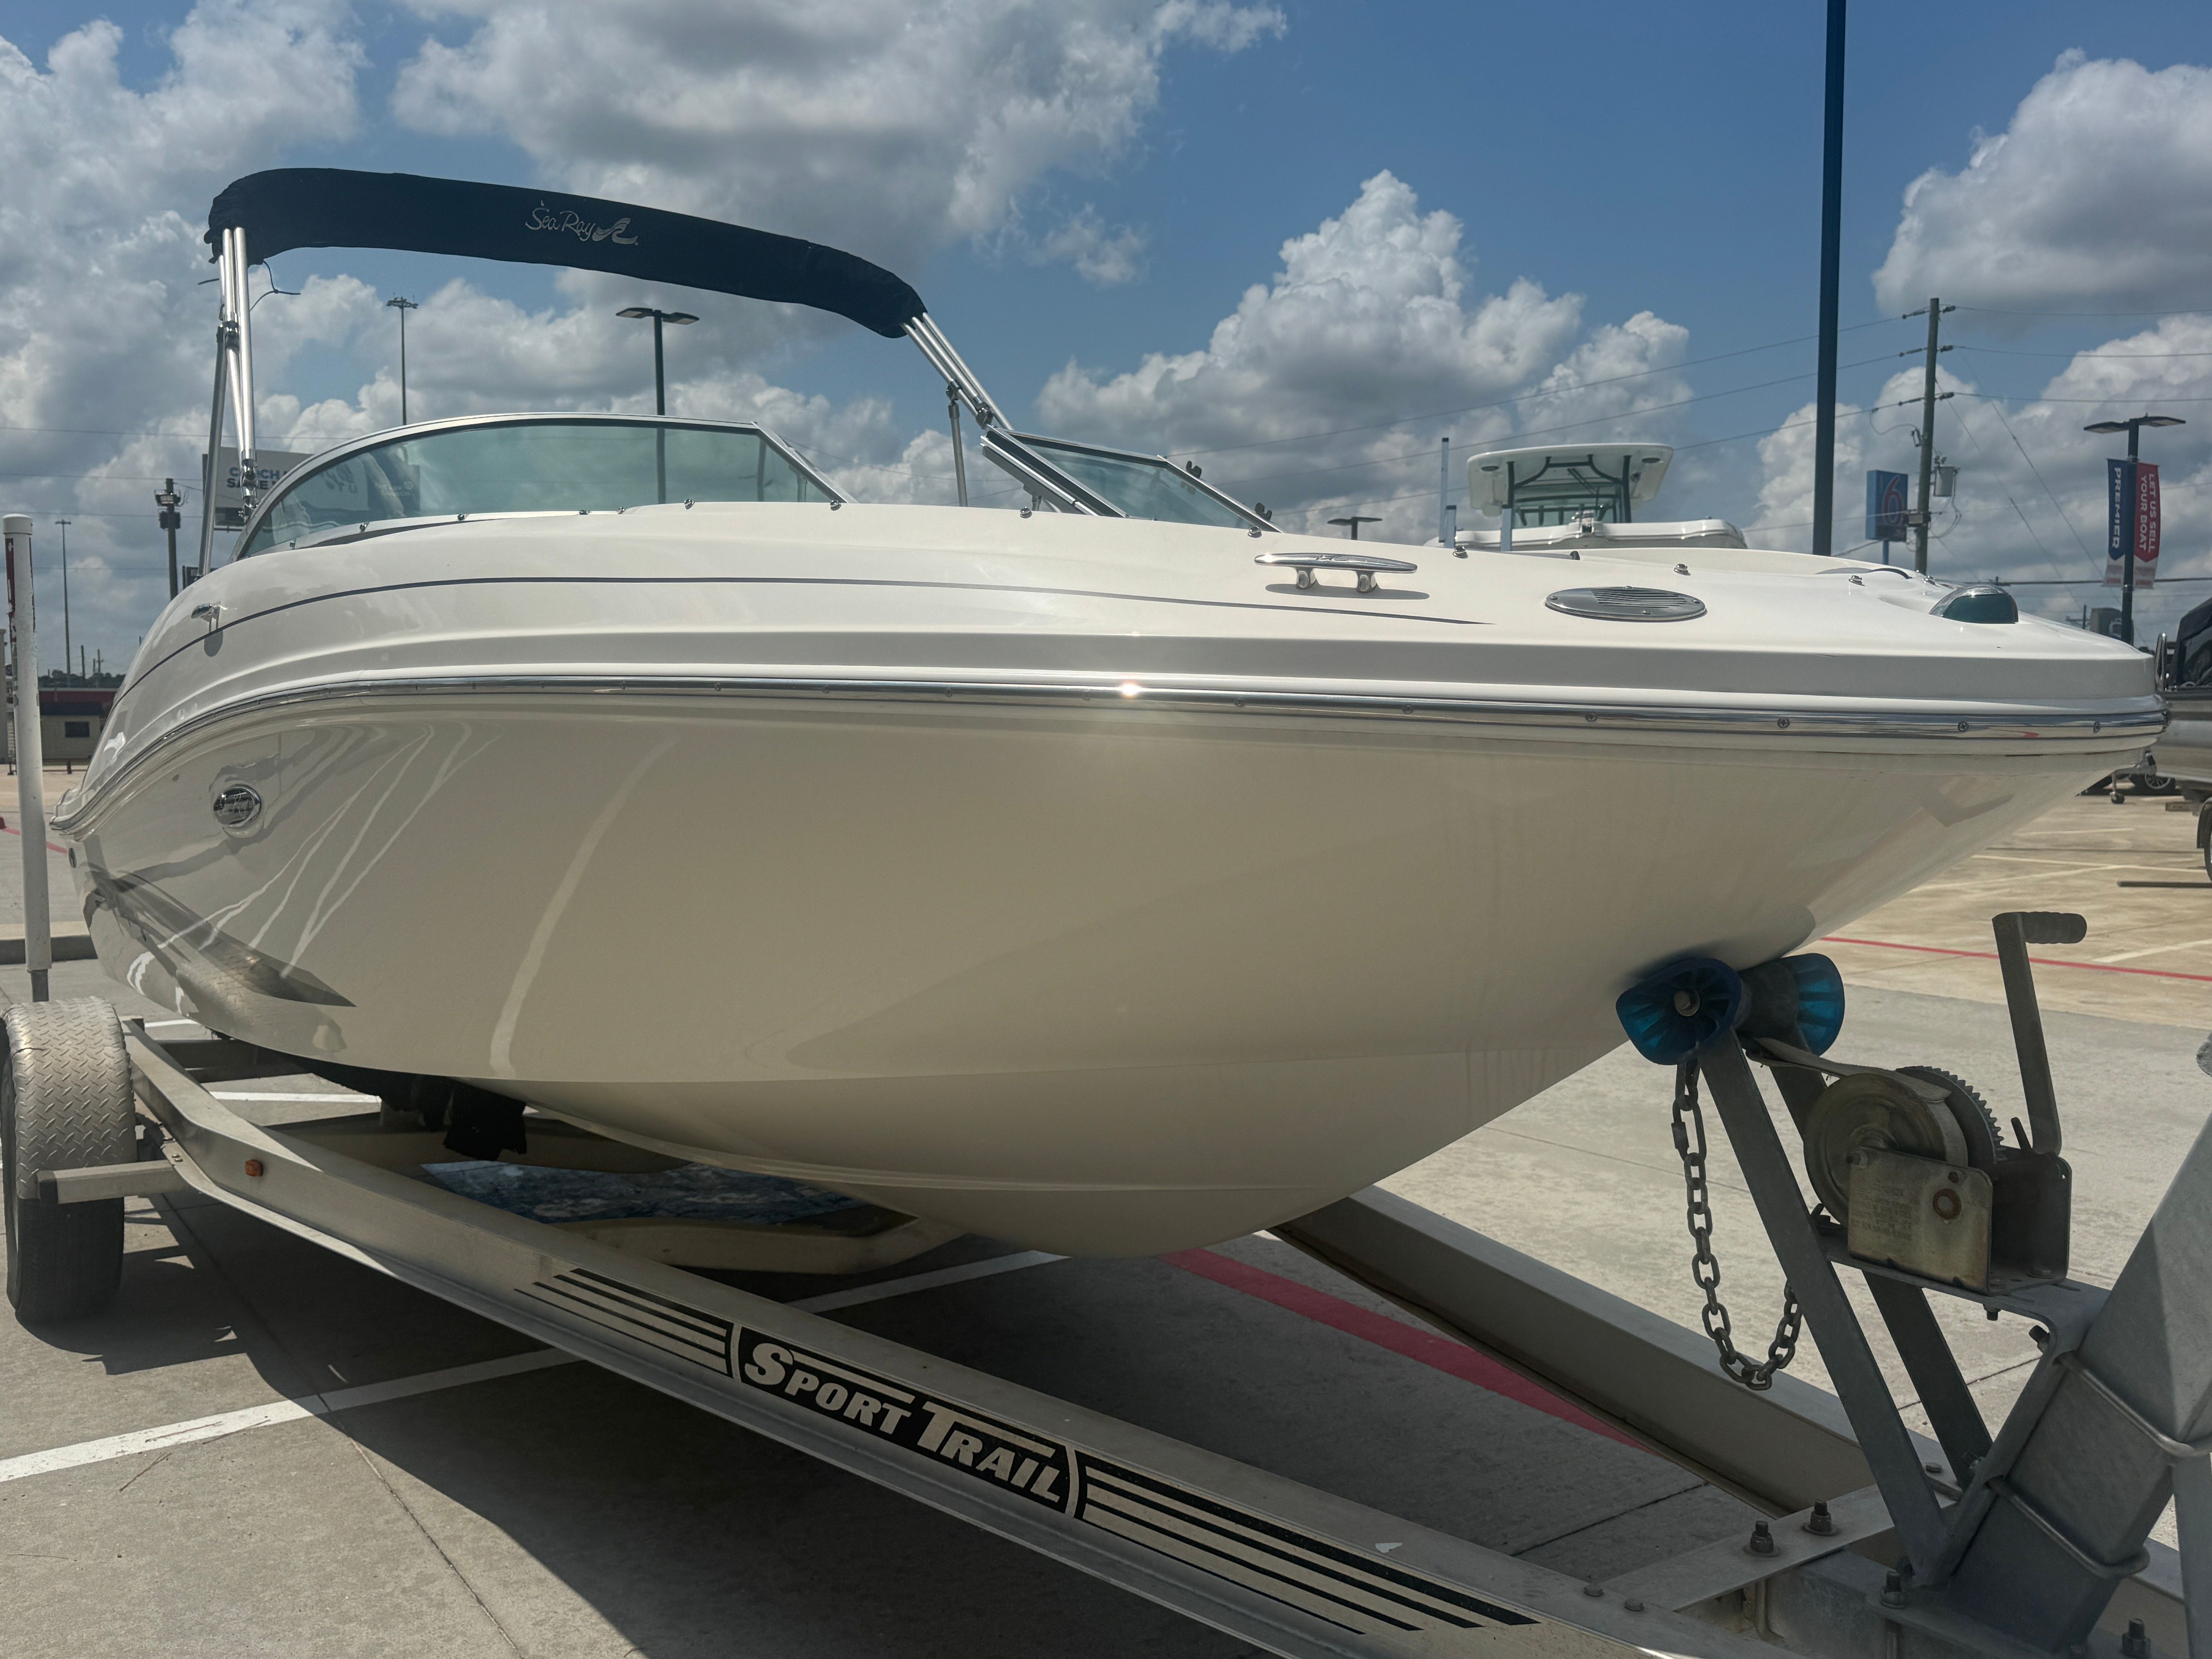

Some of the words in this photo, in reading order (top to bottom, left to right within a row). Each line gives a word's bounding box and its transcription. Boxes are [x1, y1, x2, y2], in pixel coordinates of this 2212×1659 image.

[525, 199, 560, 230] Sea
[560, 211, 596, 242] Ray
[229, 467, 280, 480] CCH
[1882, 475, 1904, 525] 6
[2112, 467, 2122, 549] PREMIER
[2149, 500, 2156, 518] US
[2139, 515, 2147, 551] BOAT
[744, 1342, 911, 1435] SPORT
[916, 1401, 1060, 1503] TRAIL
